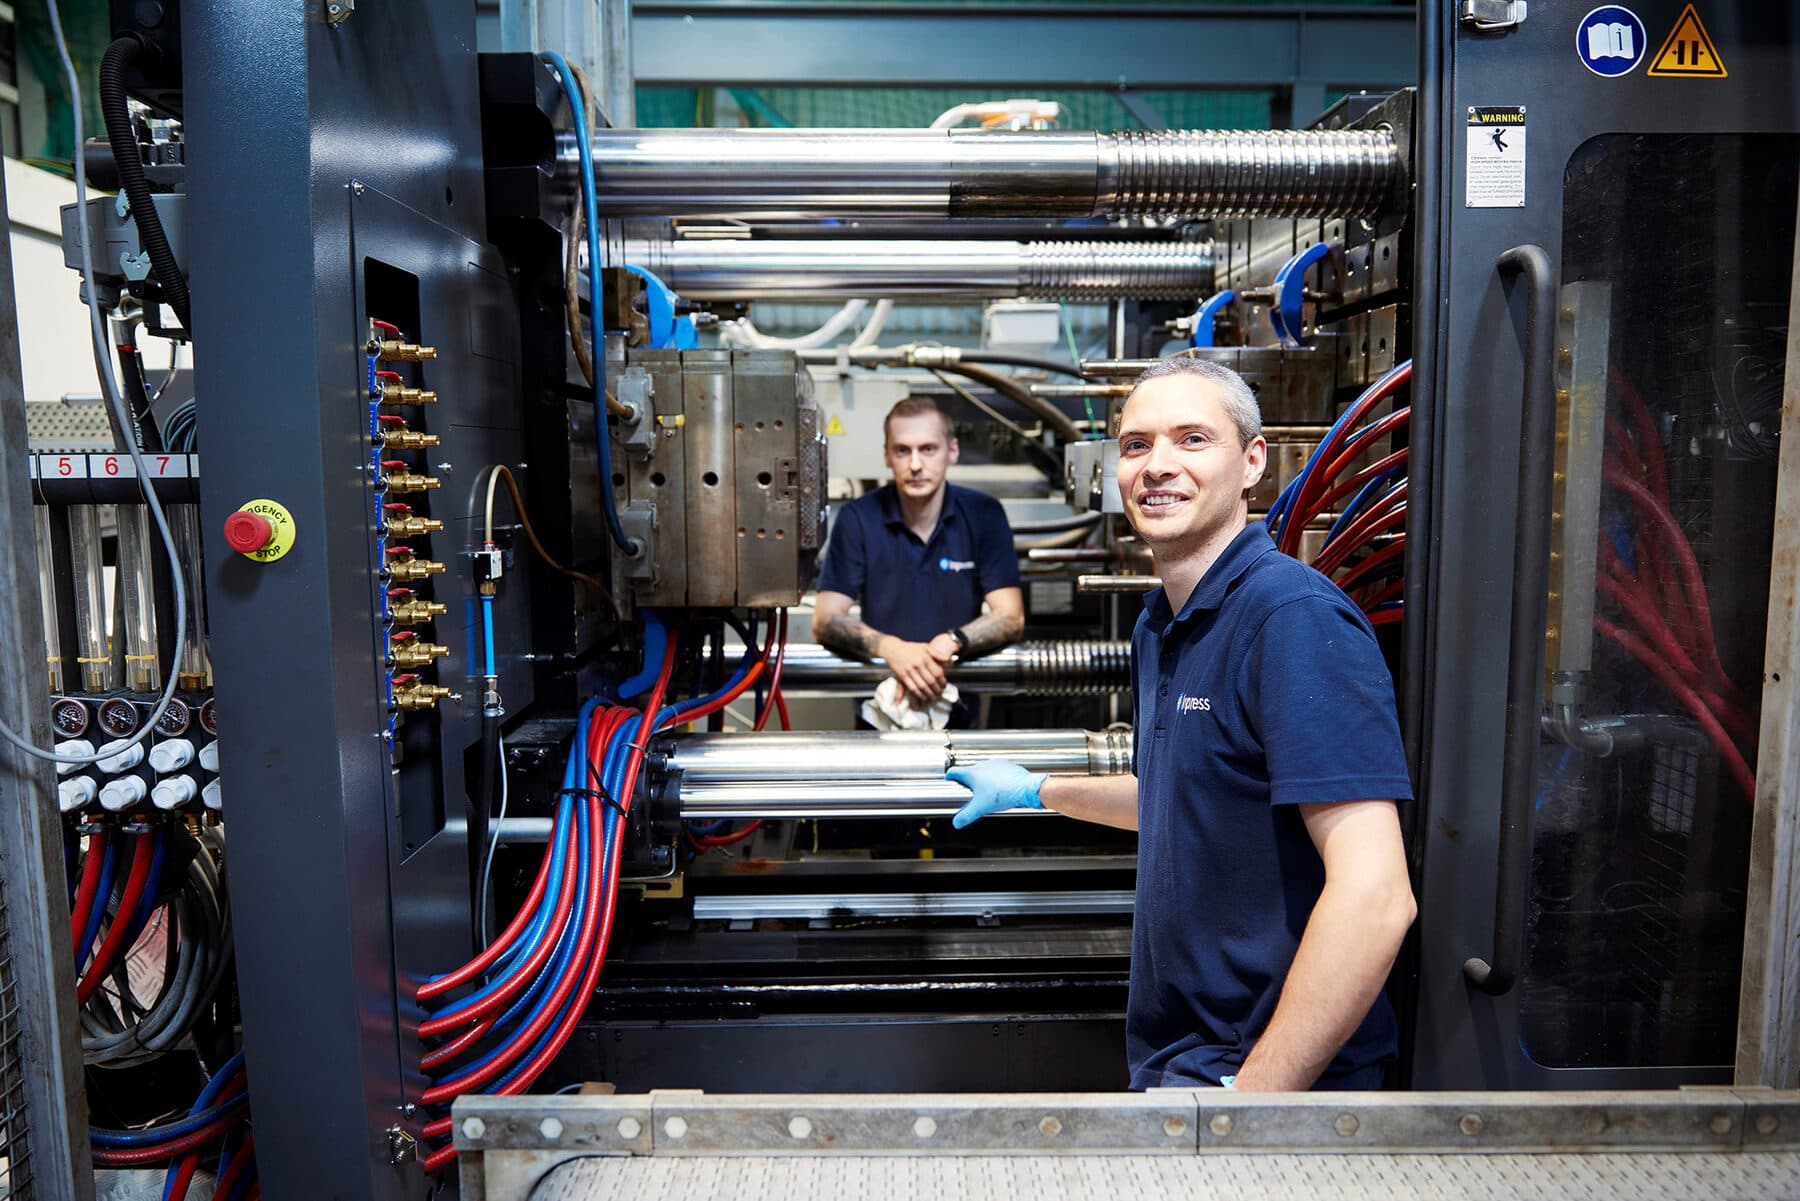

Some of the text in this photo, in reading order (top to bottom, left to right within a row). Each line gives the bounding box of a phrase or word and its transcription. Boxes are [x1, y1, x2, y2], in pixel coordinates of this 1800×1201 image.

[1481, 114, 1524, 123] WARNING
[58, 457, 72, 476] 5
[105, 457, 119, 476] 6
[156, 457, 170, 475] 7
[256, 545, 281, 558] STOP
